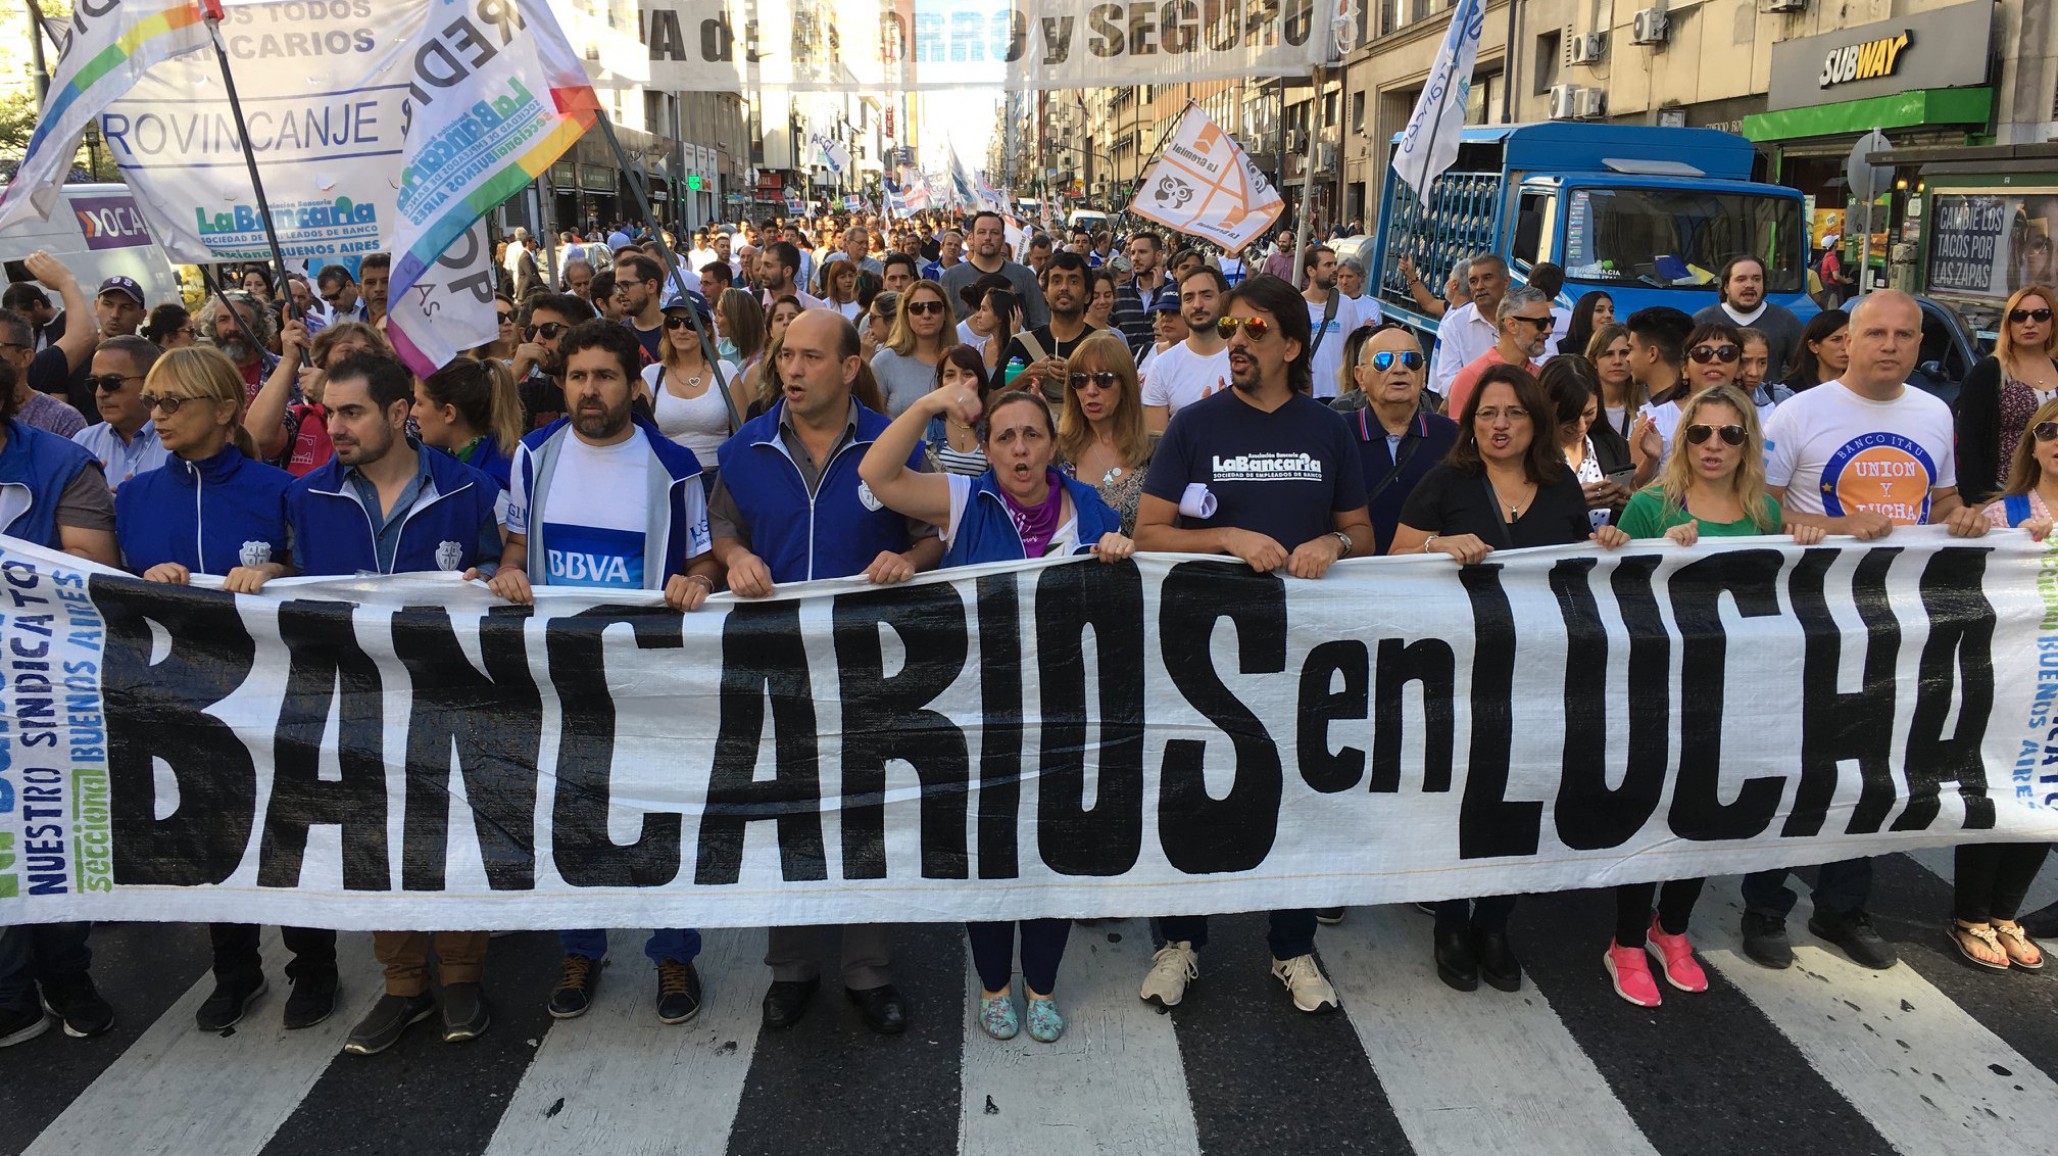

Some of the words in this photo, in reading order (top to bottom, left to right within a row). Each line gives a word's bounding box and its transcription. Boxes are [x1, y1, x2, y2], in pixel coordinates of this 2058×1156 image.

[1041, 16, 1074, 65] y
[1088, 0, 1312, 57] SEGURO
[1818, 33, 1909, 86] SUBWAY
[101, 206, 147, 238] OCA
[1939, 205, 1980, 231] CAMBIE
[1981, 204, 2004, 231] LOS
[271, 229, 324, 240] MPLEADOS
[279, 243, 335, 257] BUENOS
[339, 239, 380, 253] AIRES
[1937, 234, 1970, 259] TACOS
[1972, 235, 1994, 260] POR
[1934, 262, 1954, 284] LAS
[1955, 263, 1991, 288] ZAPAS
[1836, 434, 1886, 460] BANCO
[1891, 436, 1923, 457] ITAU
[1855, 461, 1916, 477] UNION
[1880, 482, 1893, 498] Y
[548, 549, 631, 583] BBVA
[52, 569, 102, 651] AIRES
[1, 560, 58, 748] SINDICATO
[2028, 636, 2058, 729] BUENOS
[63, 660, 105, 762] BUENOS
[89, 557, 1287, 891] BANCARIOS
[1296, 638, 1456, 794] en
[1458, 546, 1998, 860] LUCHA
[23, 767, 68, 897] NUESTRO
